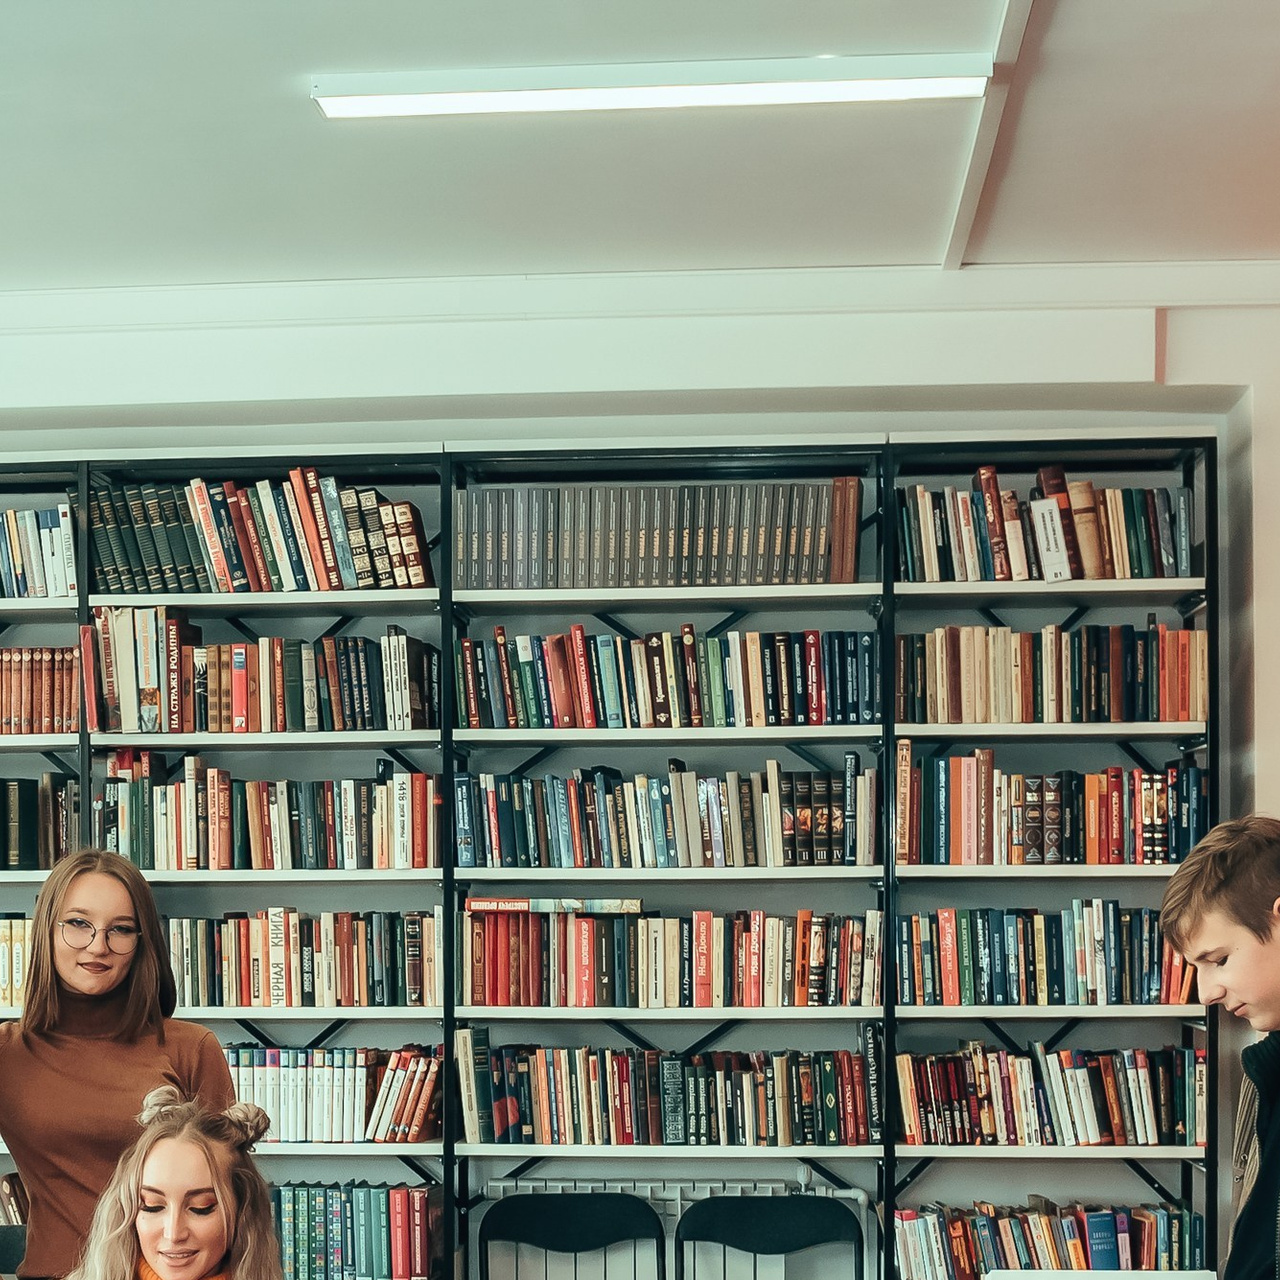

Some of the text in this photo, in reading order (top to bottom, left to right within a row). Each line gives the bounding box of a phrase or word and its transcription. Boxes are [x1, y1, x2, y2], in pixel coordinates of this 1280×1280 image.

[63, 533, 74, 568] СТАТИСТИКА
[168, 625, 179, 728] НА СТРАЖЕ РОДИНЫ
[652, 657, 664, 703] Криминология
[615, 785, 629, 857] СОЦИАЛЬНАЯ РАБОТА
[802, 850, 809, 860] II
[817, 850, 827, 860] III
[833, 850, 844, 860] IV
[270, 911, 284, 1004] ЧЕРНАЯ КНИГА
[581, 922, 589, 965] ШОПЕНГАУЭР
[699, 922, 707, 976] Жак Дюкло
[751, 921, 759, 953] Дюкло
